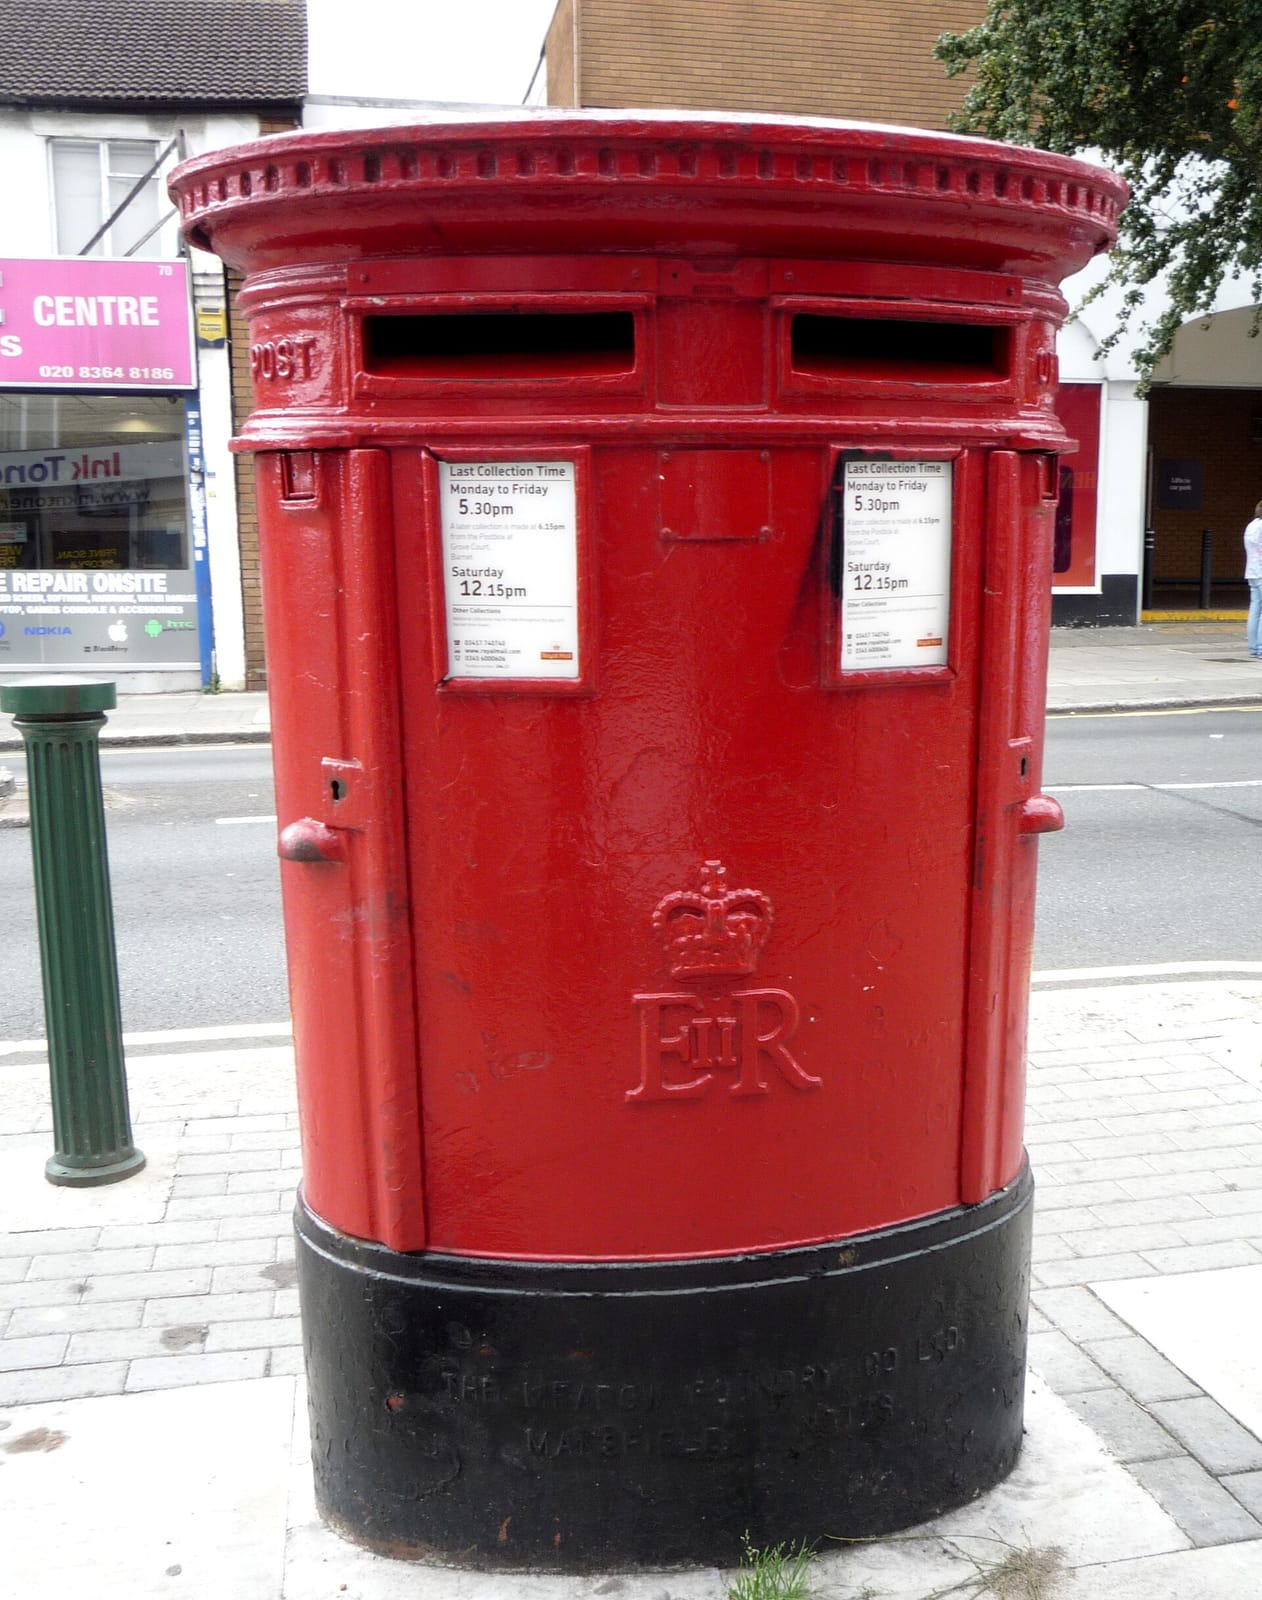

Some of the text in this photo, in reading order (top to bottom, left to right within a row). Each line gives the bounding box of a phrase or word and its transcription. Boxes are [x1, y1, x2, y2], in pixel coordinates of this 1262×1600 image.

[158, 265, 173, 277] 70
[33, 295, 160, 327] CENTRE
[39, 365, 174, 380] 020 8364 8186
[450, 465, 566, 477] Last Collection Time
[847, 463, 942, 474] Last Collection Time
[450, 484, 549, 496] Monday to Friday
[847, 480, 928, 493] Monday to Friday
[459, 498, 514, 517] 5.30pm
[855, 495, 900, 512] 5.30pm
[452, 567, 503, 579] Saturday
[847, 561, 890, 572] Saturday
[12, 572, 88, 592] REPAIR
[93, 572, 167, 593] ONSITE
[854, 574, 909, 591] 12.15pm
[460, 580, 527, 599] 12.15pm
[23, 626, 72, 635] NOKIA
